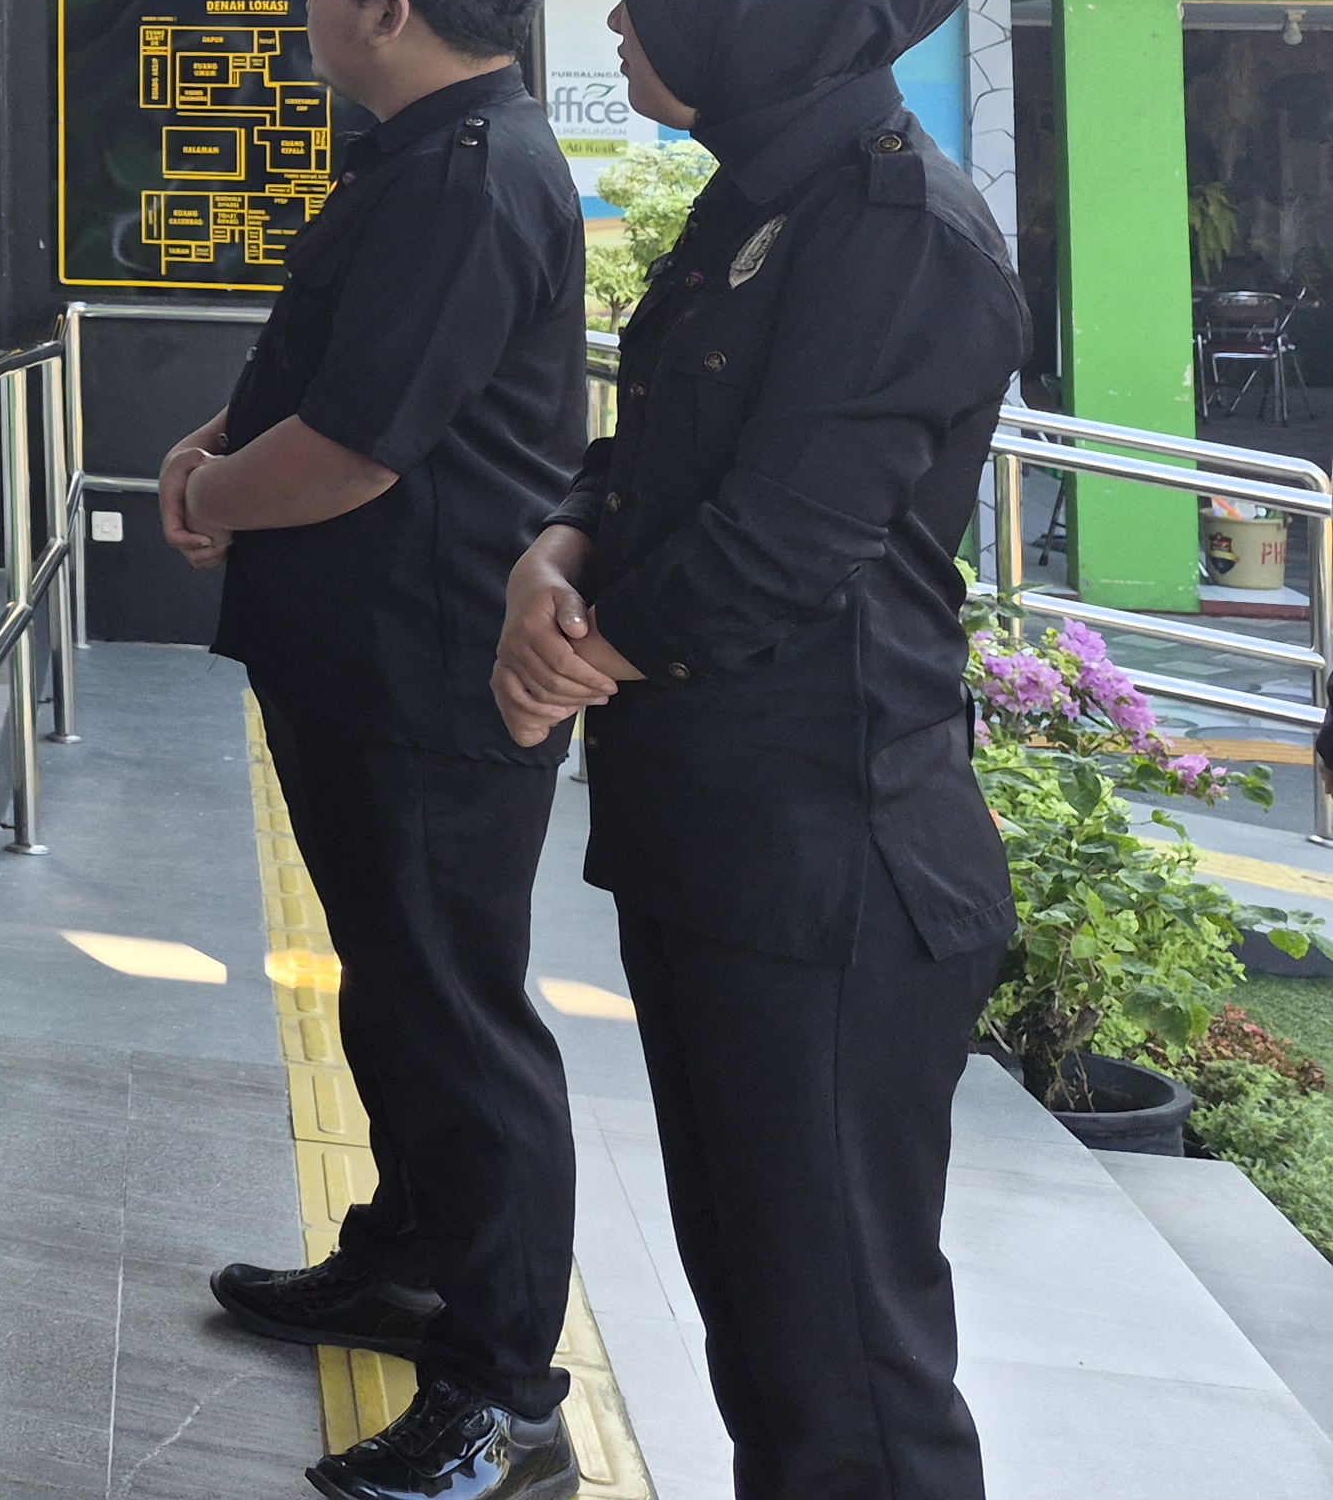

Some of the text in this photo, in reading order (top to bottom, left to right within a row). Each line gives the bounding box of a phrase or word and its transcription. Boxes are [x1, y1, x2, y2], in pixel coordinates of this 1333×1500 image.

[206, 0, 289, 12] DENAH LOKASI
[557, 127, 627, 136] LINGKUNGAN
[565, 142, 582, 153] Ati
